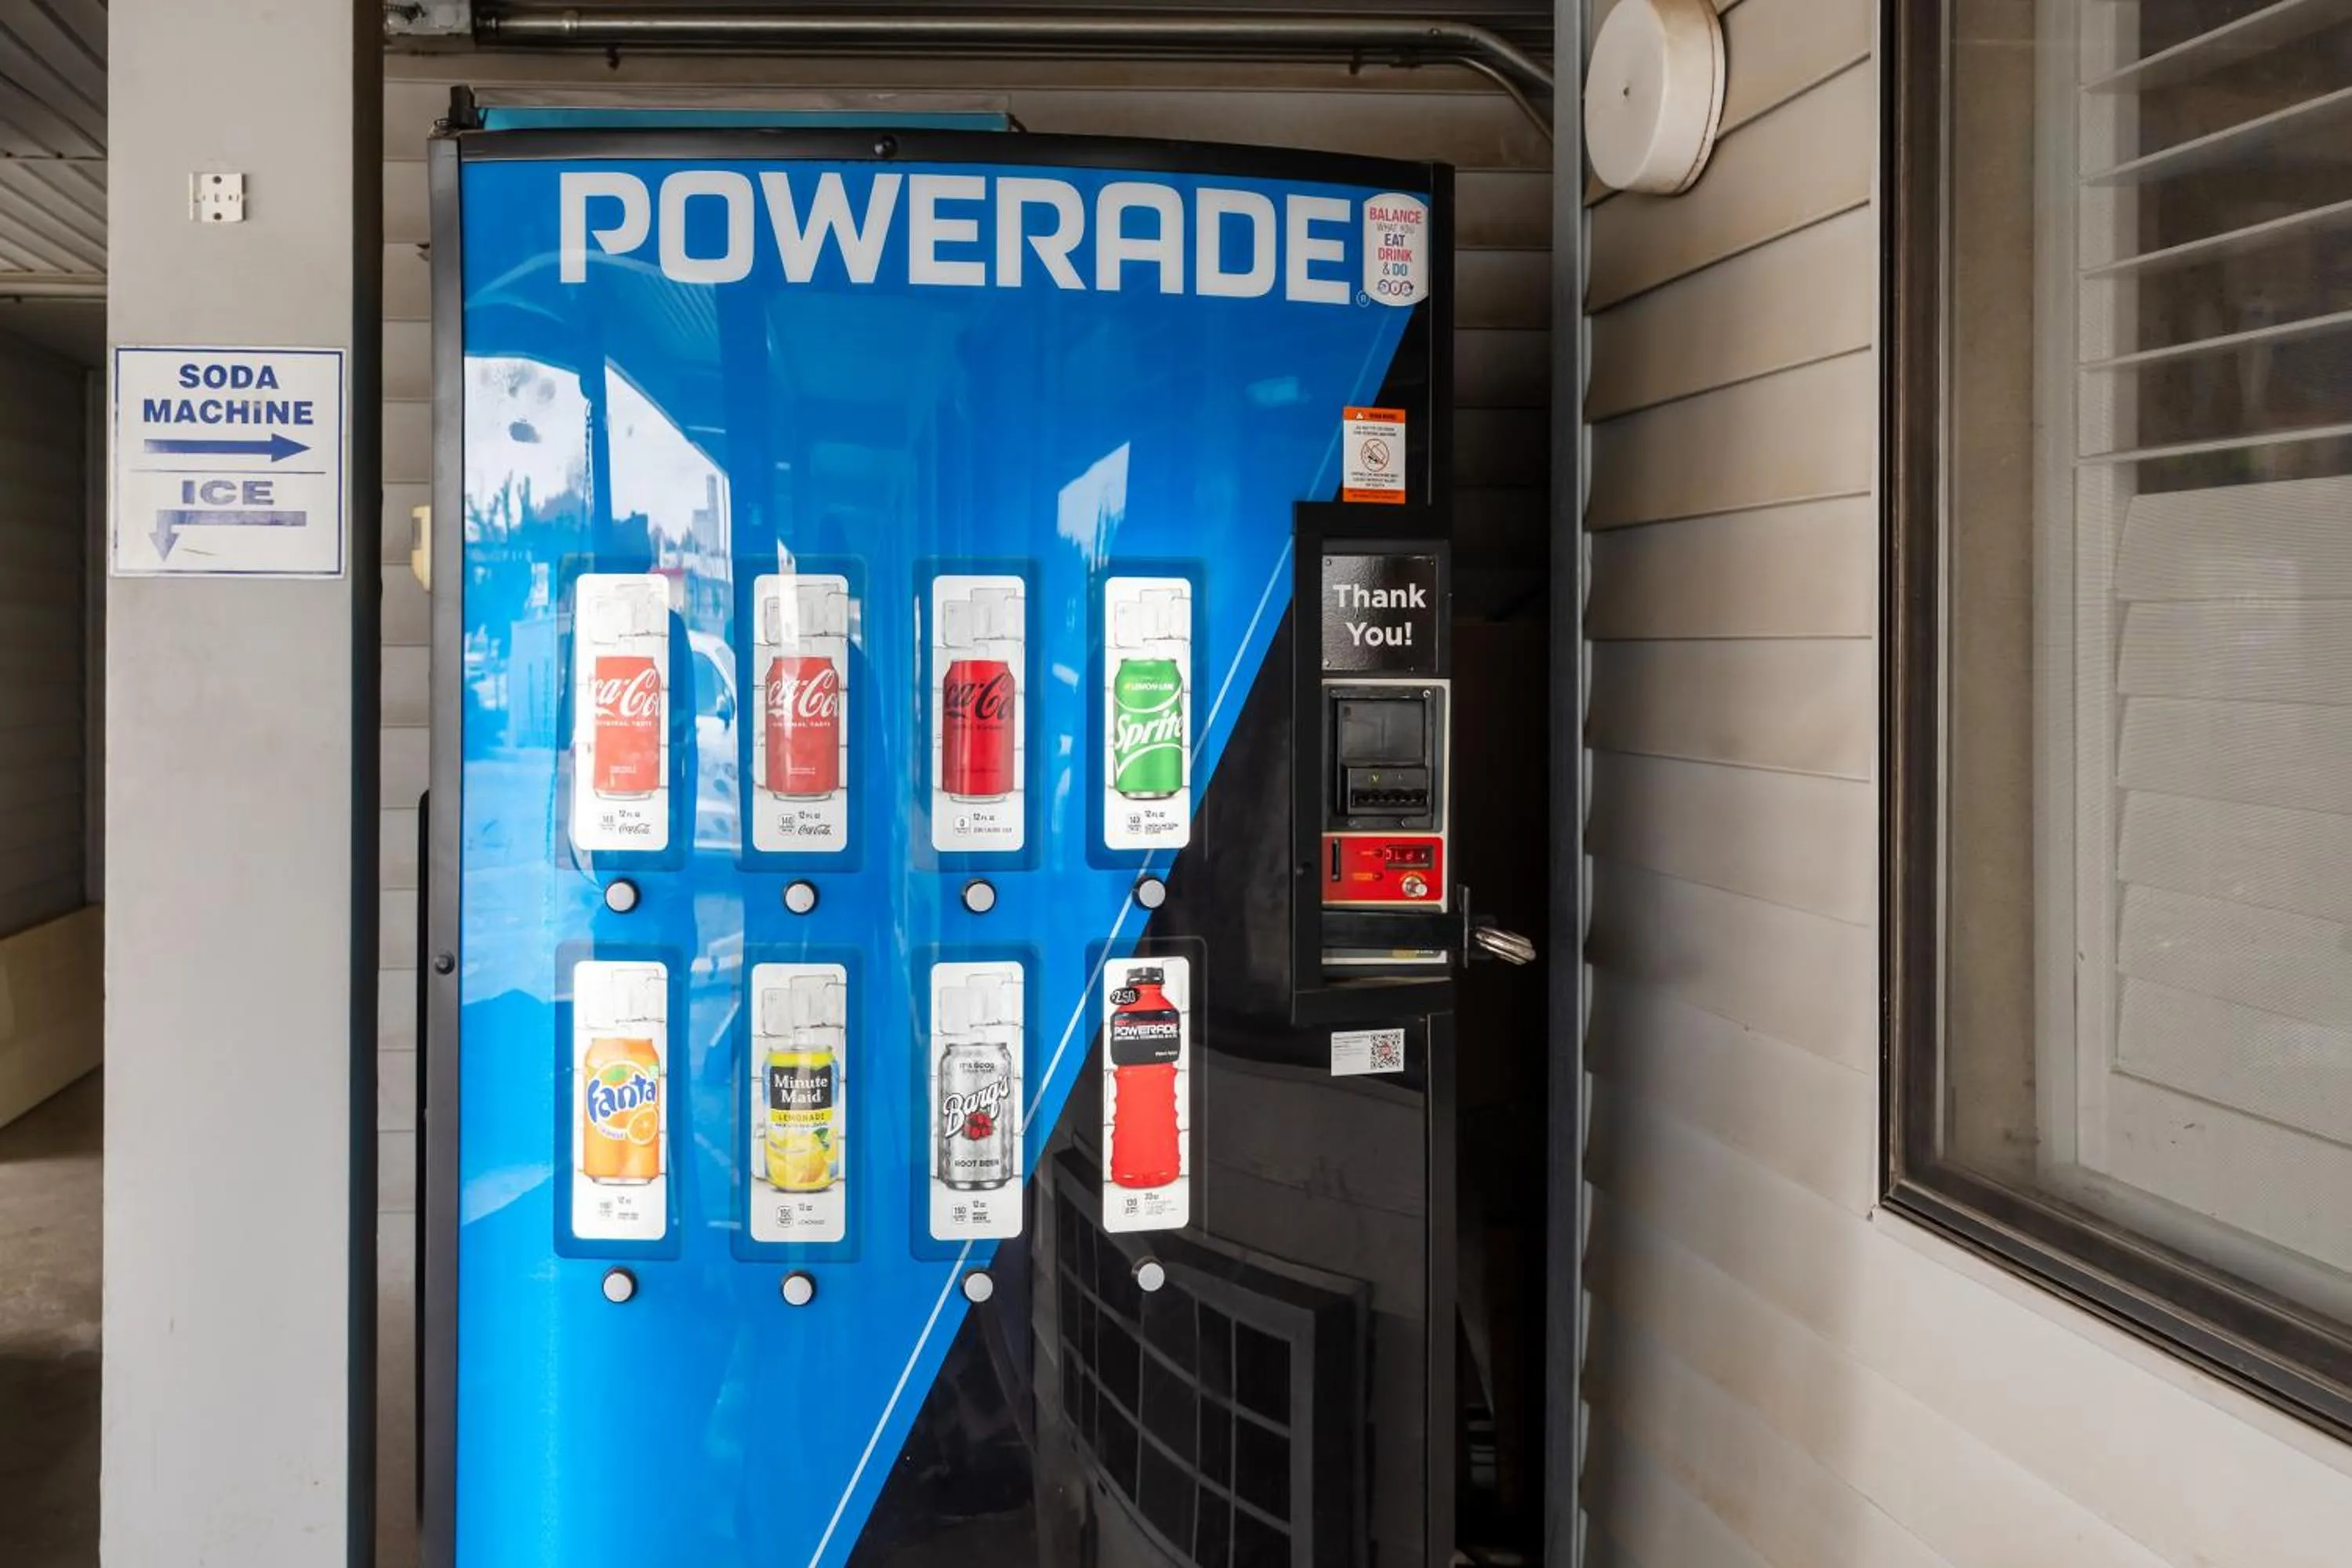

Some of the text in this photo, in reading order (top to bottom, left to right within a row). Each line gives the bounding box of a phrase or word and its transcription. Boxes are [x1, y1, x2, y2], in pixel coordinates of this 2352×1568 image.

[1369, 206, 1422, 224] BALANCE
[559, 171, 1352, 305] POWERADE
[1385, 233, 1405, 247] EAT
[1377, 247, 1412, 262] DRINK
[1382, 262, 1408, 276] & DO
[178, 363, 280, 390] SODA
[143, 398, 314, 426] MACHINE
[180, 480, 274, 506] ICE
[1333, 583, 1427, 608] Thank
[1345, 622, 1413, 647] You!
[774, 1073, 828, 1089] Minute
[781, 1089, 822, 1103] Maid
[943, 1075, 1011, 1138] Barq's
[778, 1112, 825, 1122] LEMONADE
[954, 1160, 977, 1168] ROOT
